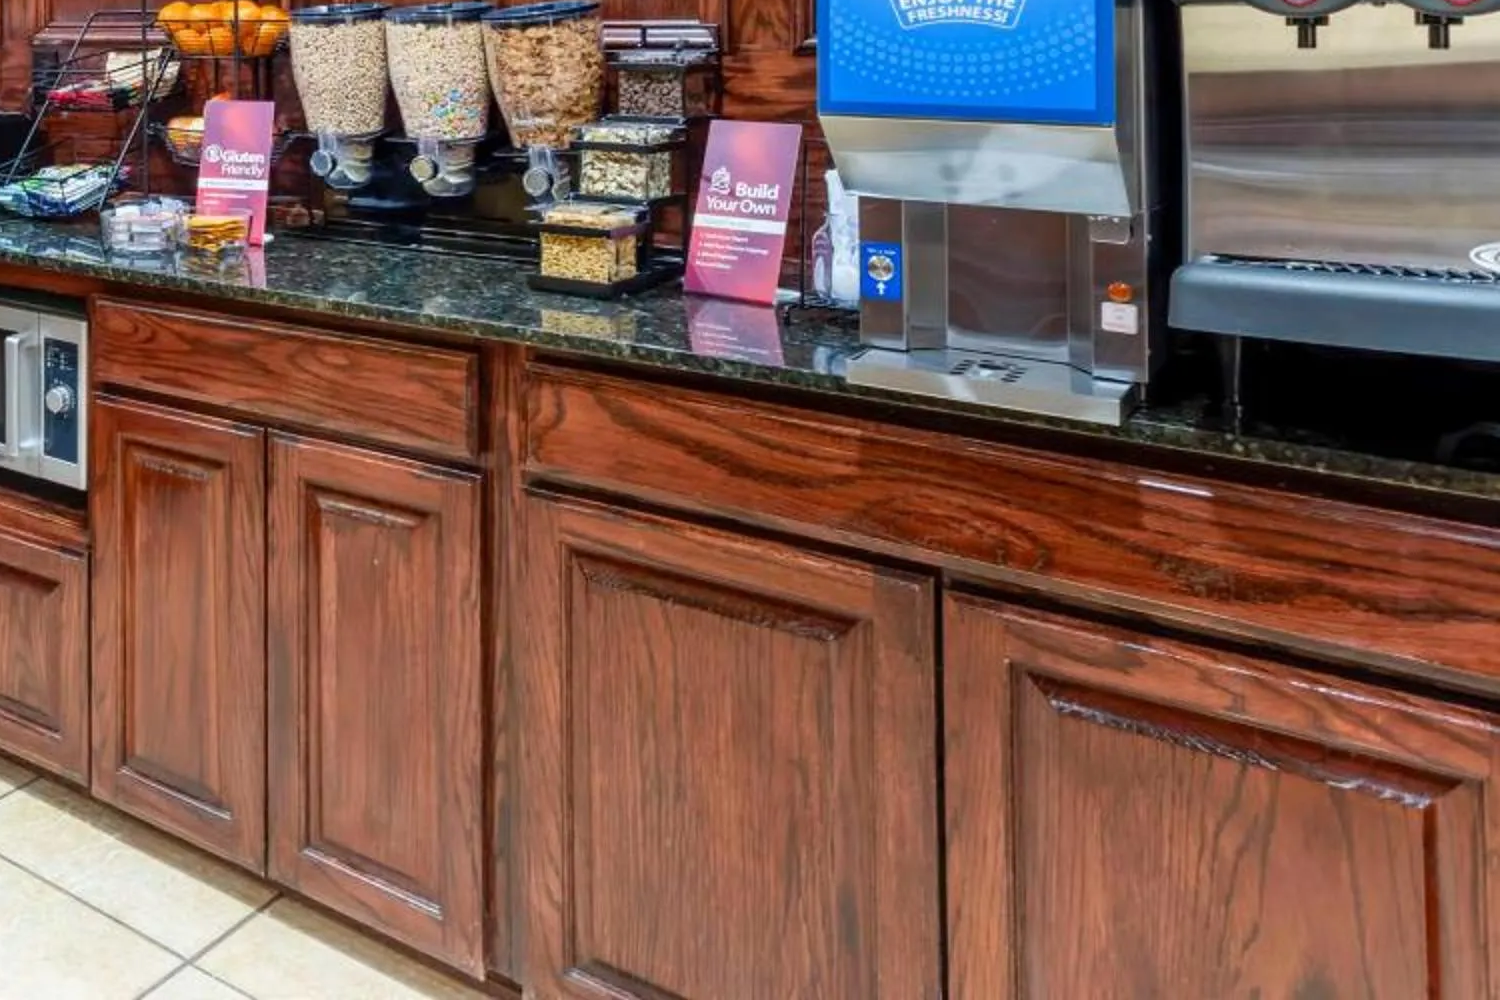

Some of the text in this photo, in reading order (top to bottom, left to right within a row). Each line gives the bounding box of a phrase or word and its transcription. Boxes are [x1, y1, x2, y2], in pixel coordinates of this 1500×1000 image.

[907, 5, 1010, 24] FRESHNESS!
[222, 151, 265, 164] Gluten
[221, 163, 265, 178] Friendly
[735, 181, 780, 200] Build
[707, 195, 777, 216] Your Own
